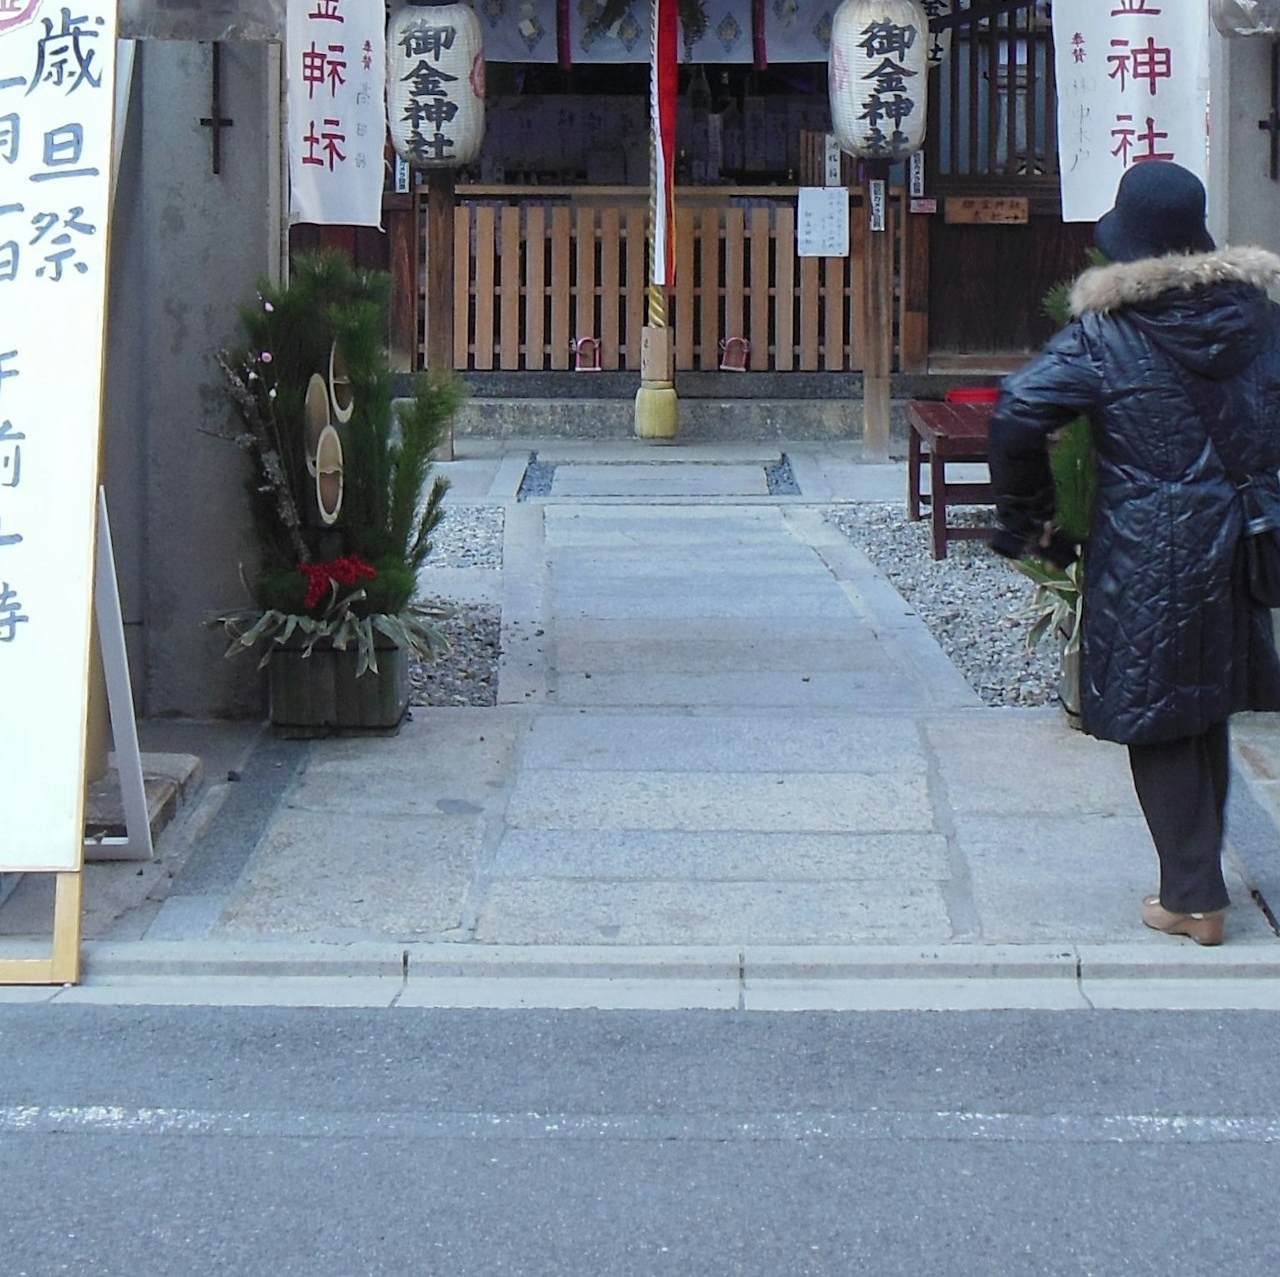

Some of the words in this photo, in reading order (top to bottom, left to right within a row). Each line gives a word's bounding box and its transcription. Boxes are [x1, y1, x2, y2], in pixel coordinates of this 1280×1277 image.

[24, 7, 105, 283] 歳旦祭
[397, 19, 459, 162] 御金神社
[857, 19, 918, 158] 御金神社
